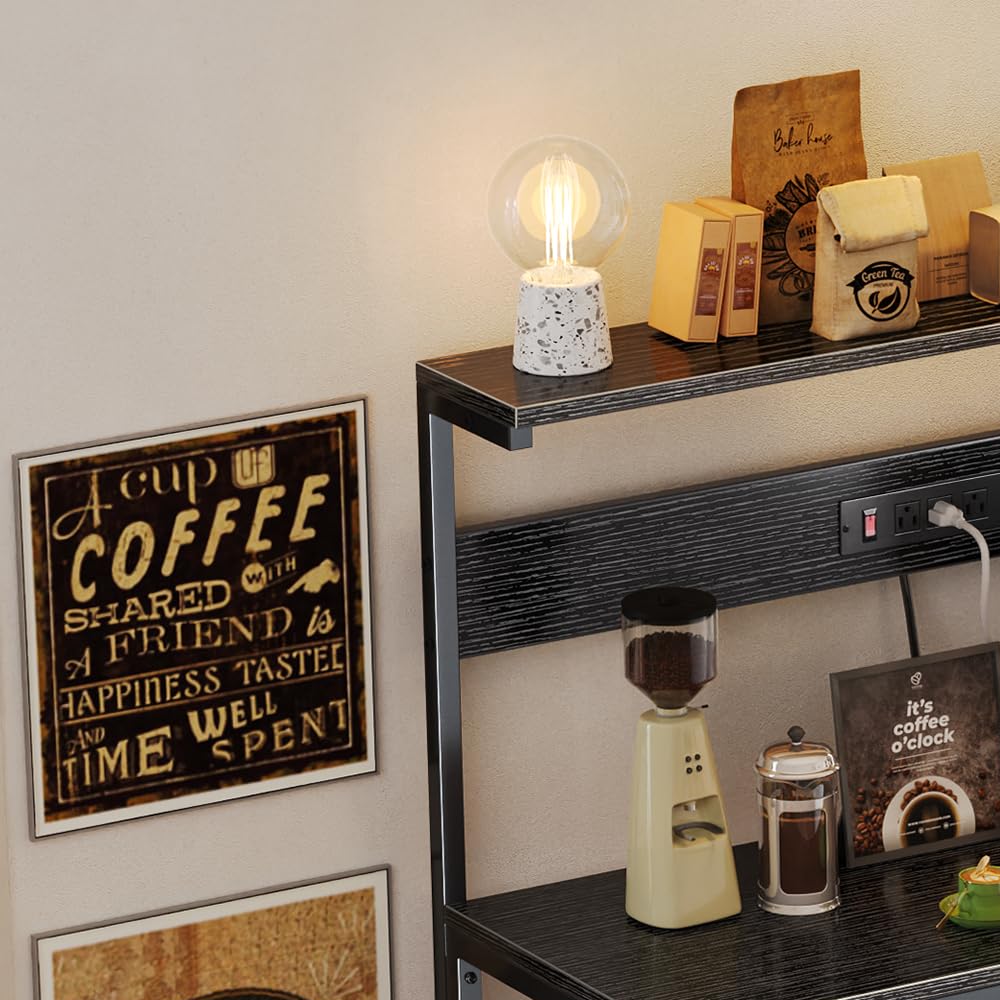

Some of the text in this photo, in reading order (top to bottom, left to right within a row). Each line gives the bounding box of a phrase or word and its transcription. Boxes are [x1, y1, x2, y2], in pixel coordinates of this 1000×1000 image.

[861, 267, 906, 283] Green Tea
[51, 471, 113, 540] A
[70, 473, 331, 603] COFFEE
[64, 556, 297, 635] SHARED WITH
[64, 604, 336, 680] A FRIEND is
[67, 690, 278, 757] AND WELL
[891, 729, 955, 754] o'clock
[893, 713, 951, 736] coffee
[906, 699, 934, 717] it's
[62, 698, 348, 797] TIME SPENT
